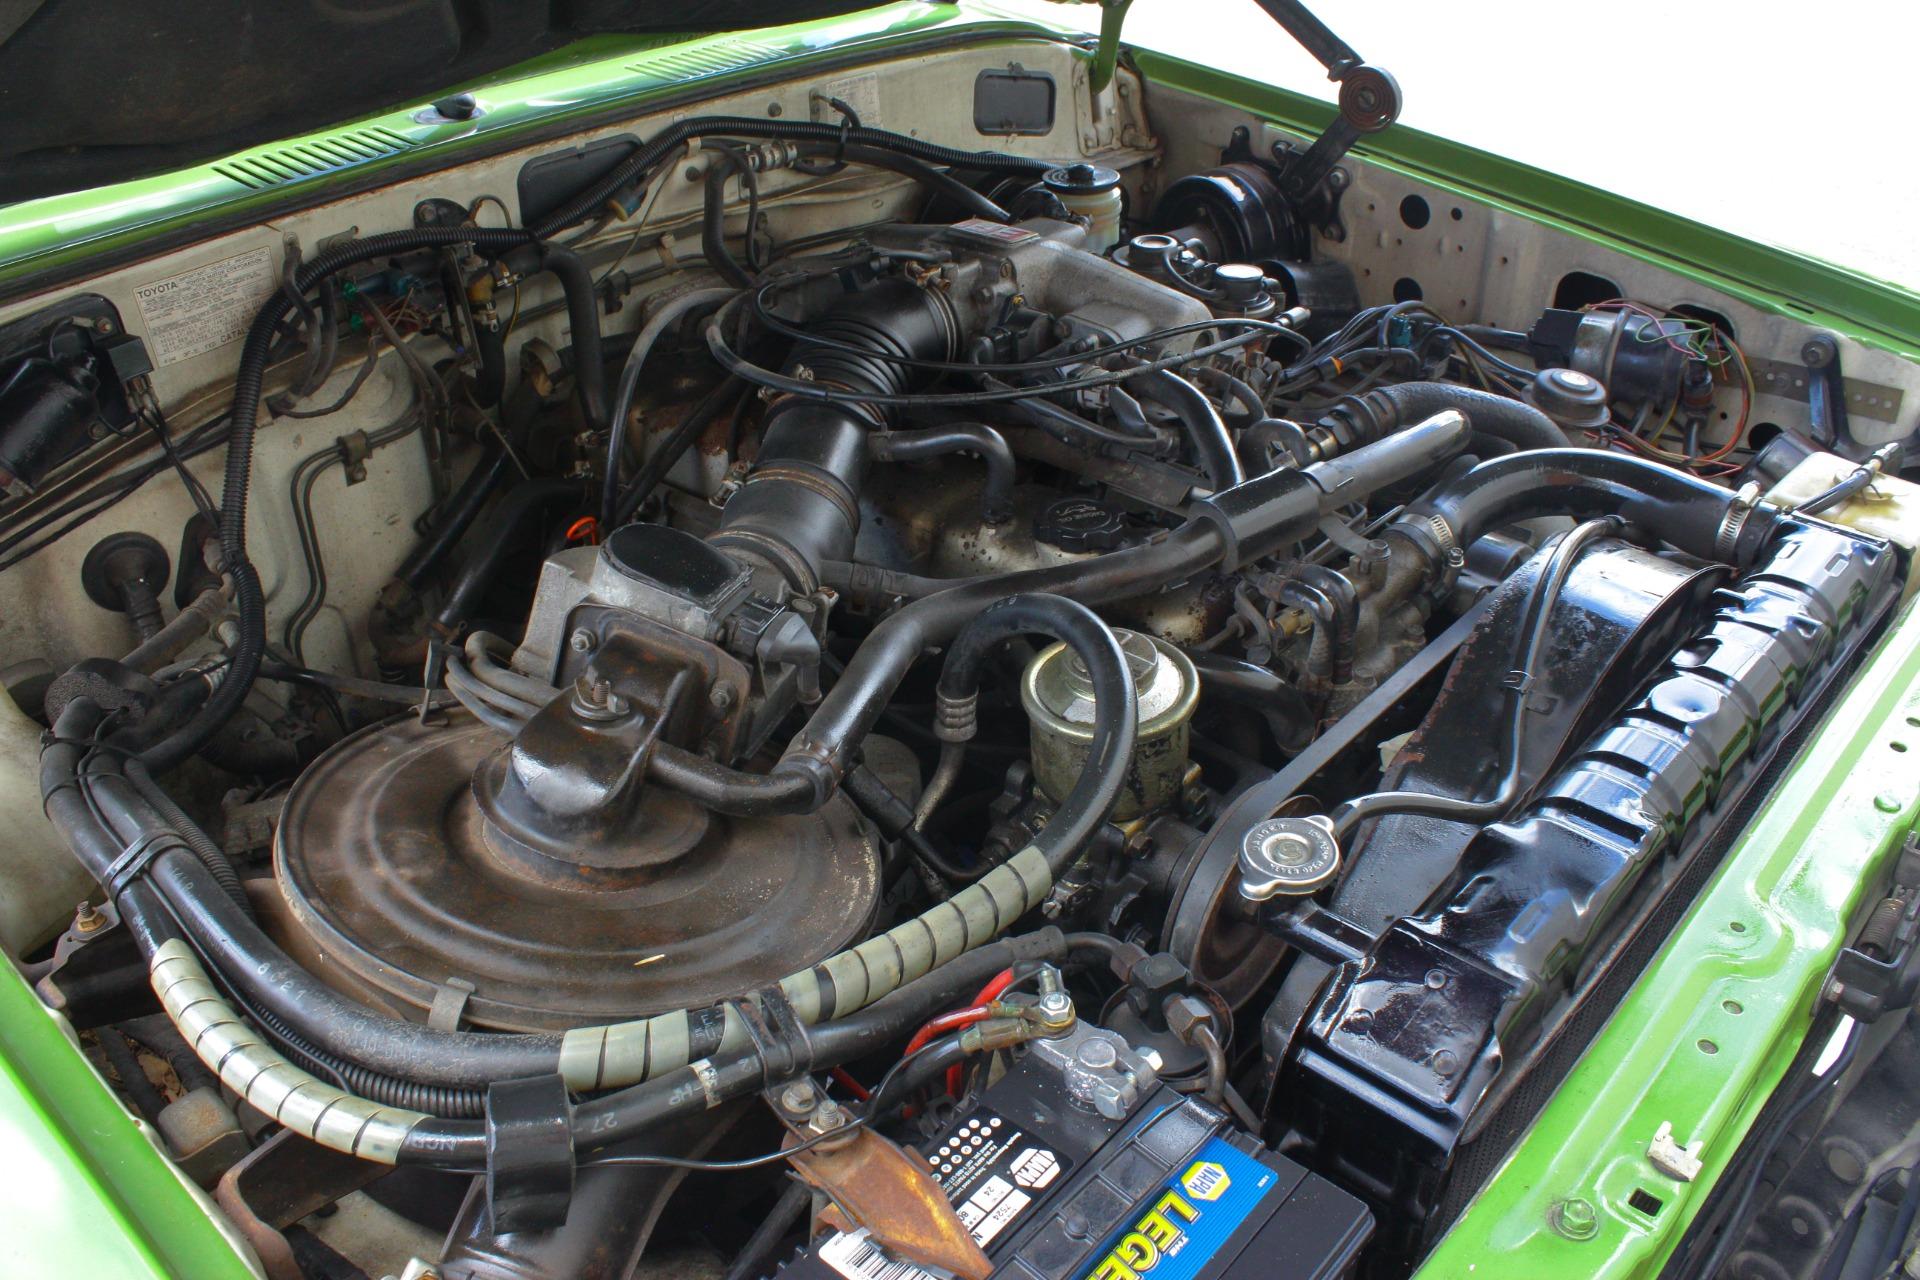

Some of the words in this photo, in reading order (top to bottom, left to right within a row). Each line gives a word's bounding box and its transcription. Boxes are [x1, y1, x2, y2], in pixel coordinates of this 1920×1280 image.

[138, 281, 178, 299] TOYOTA
[1016, 1152, 1053, 1184] NAPA
[983, 1185, 995, 1196] 24
[1189, 1165, 1222, 1196] NAPA
[992, 1203, 1012, 1221] 7524
[1168, 1235, 1189, 1258] THE
